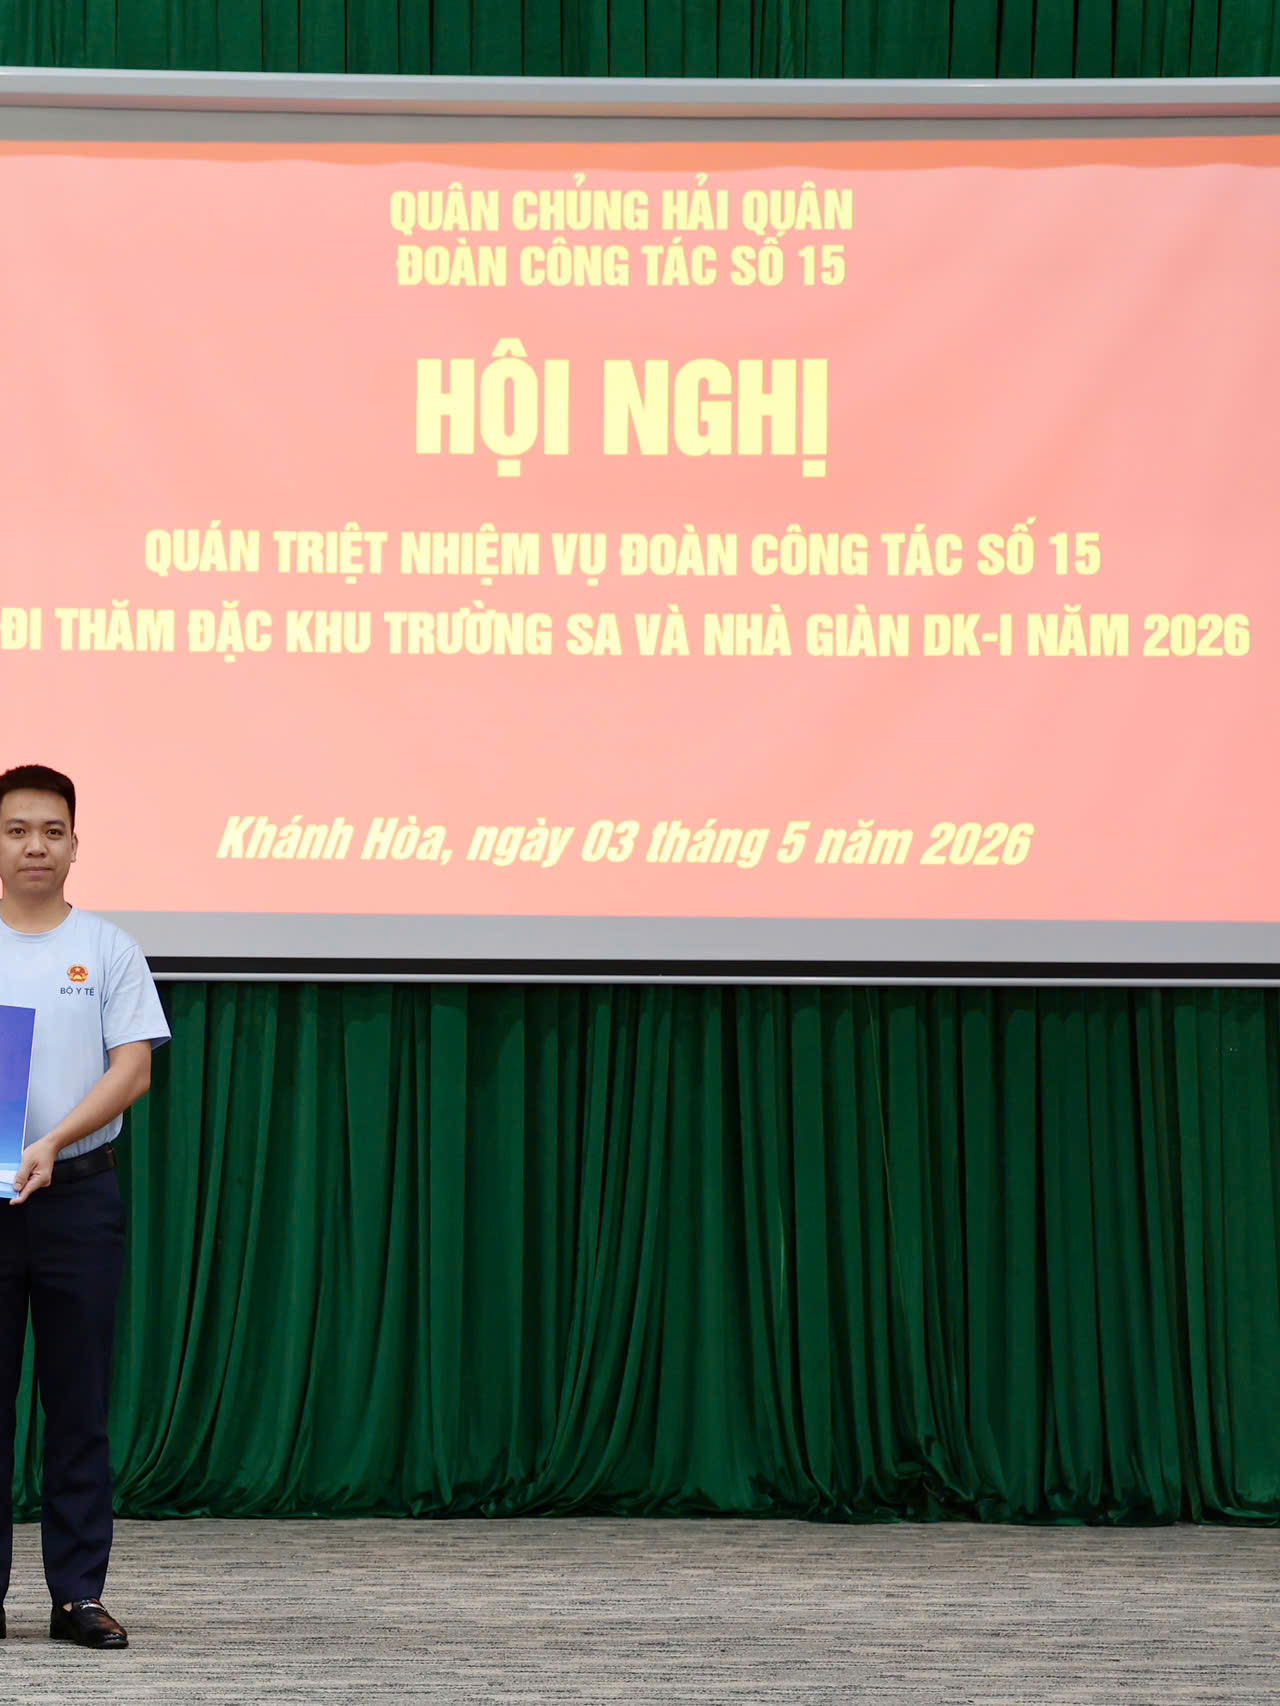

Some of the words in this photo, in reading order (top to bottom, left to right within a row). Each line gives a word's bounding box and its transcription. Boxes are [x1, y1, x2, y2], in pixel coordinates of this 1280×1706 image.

[390, 182, 500, 236] QUÂN
[512, 173, 649, 231] CHỦNG
[662, 173, 728, 230] HẢI
[743, 181, 853, 236] QUÂN
[396, 237, 507, 286] ĐOÀN
[520, 237, 630, 286] CÔNG
[641, 236, 717, 286] TÁC
[730, 231, 784, 286] SỐ
[798, 245, 845, 285] 15
[416, 338, 569, 477] HỘI
[604, 359, 828, 478] NGHỊ
[145, 520, 260, 577] QUÁN
[273, 521, 388, 584] TRIỆT
[400, 523, 540, 586] NHIỆM
[552, 533, 607, 586] VỤ
[620, 524, 737, 576] ĐOÀN
[752, 524, 868, 576] CÔNG
[881, 524, 963, 576] TÁC
[977, 517, 1036, 576] SỐ
[1049, 532, 1101, 576] 15
[0, 608, 42, 650] ĐI
[56, 600, 176, 652] THĂM
[187, 601, 272, 664] ĐẶC
[286, 611, 372, 654] KHU
[384, 600, 552, 656] TRƯỜNG
[566, 613, 622, 656] SA
[635, 604, 690, 656] VÀ
[704, 604, 792, 656] NHÀ
[807, 604, 909, 656] GIÀN
[924, 614, 1012, 656] DK-I
[1027, 604, 1129, 656] NĂM
[1144, 614, 1250, 656] 2026
[216, 816, 355, 860] Khánh
[360, 816, 453, 865] Hòa,
[466, 817, 576, 868] ngày
[582, 820, 640, 863] 03
[646, 818, 770, 868] tháng
[776, 821, 811, 864] 5
[815, 819, 914, 864] năm
[920, 822, 1035, 865] 2026
[76, 987, 81, 995] Y
